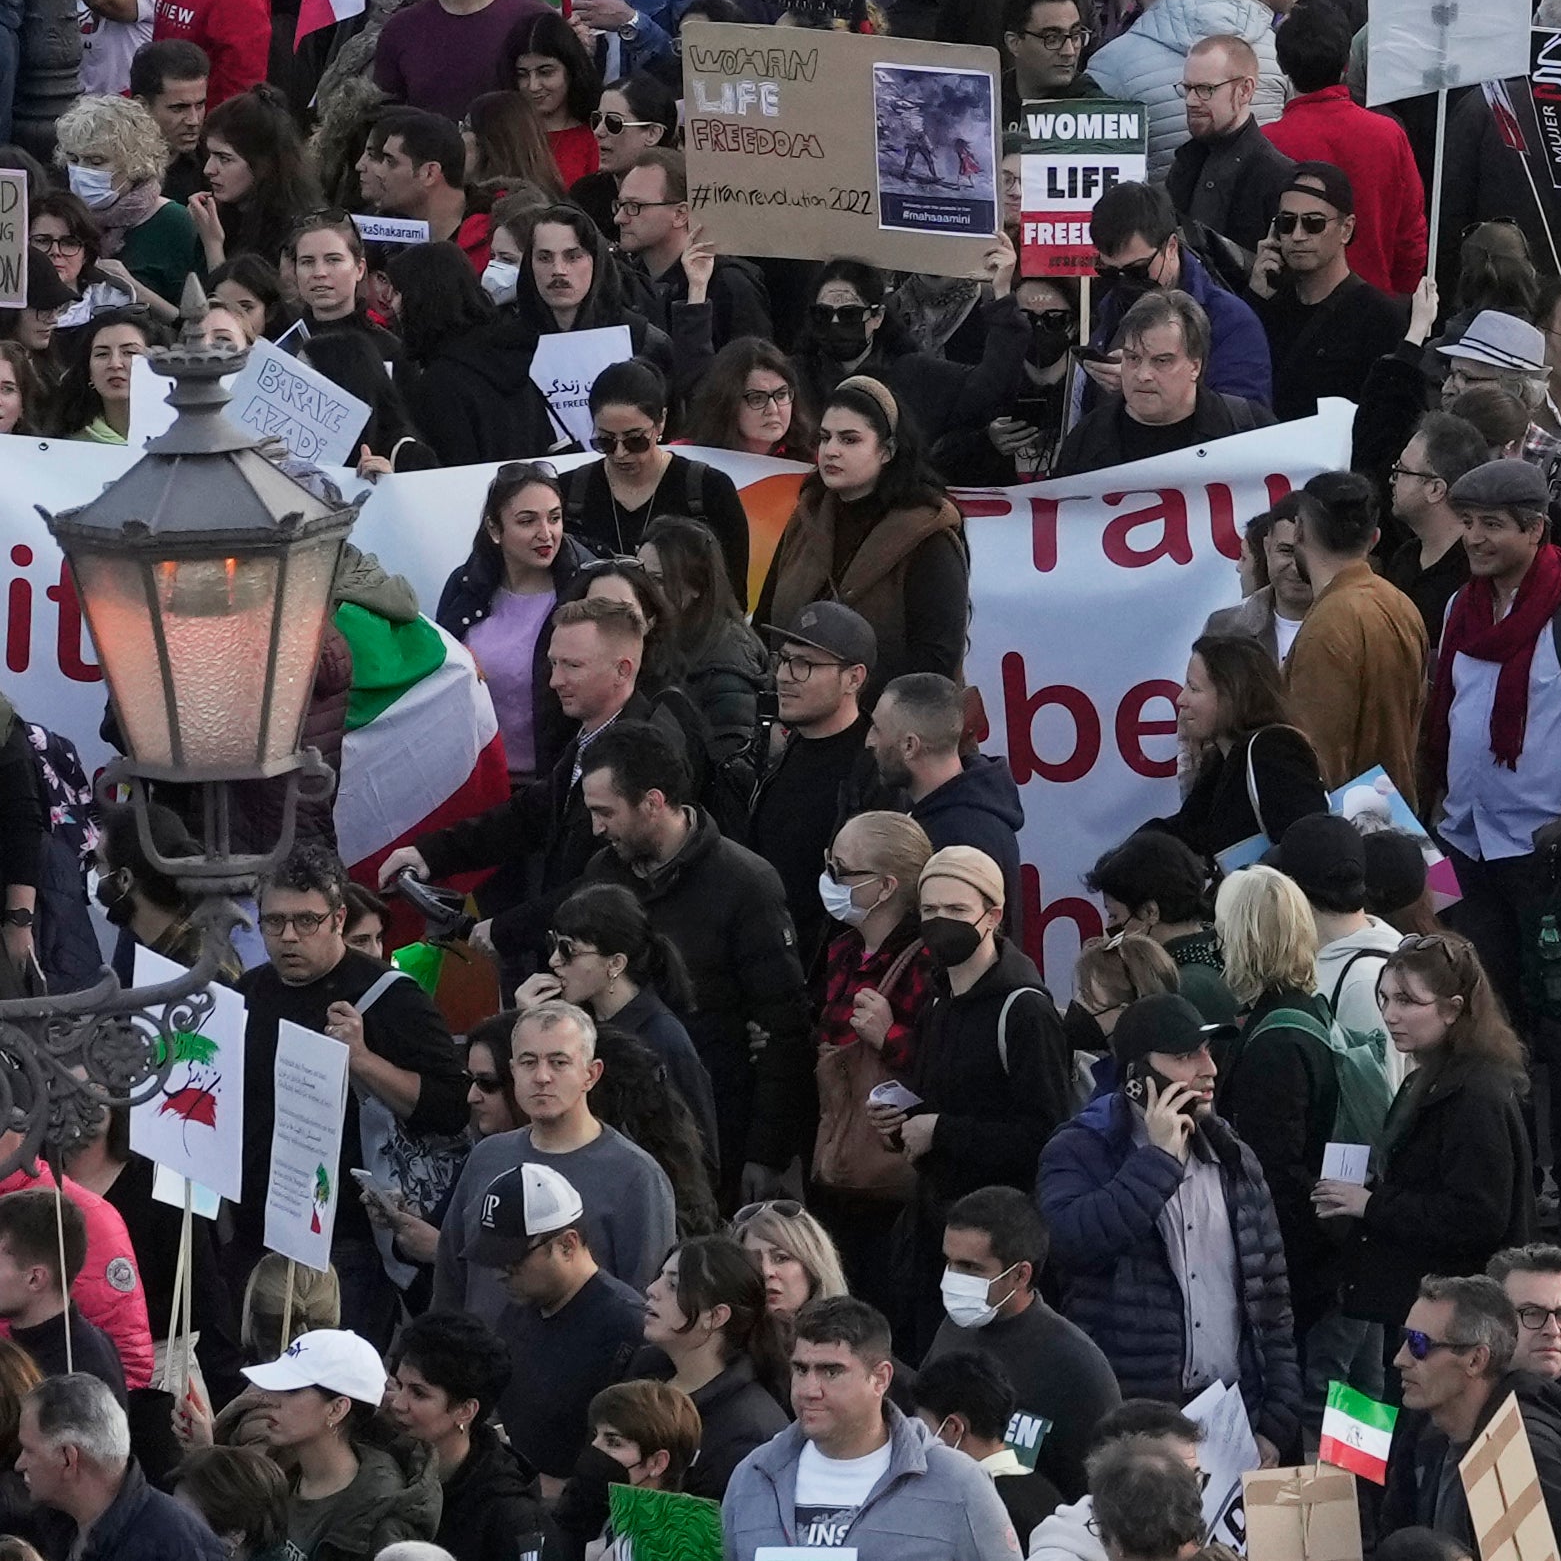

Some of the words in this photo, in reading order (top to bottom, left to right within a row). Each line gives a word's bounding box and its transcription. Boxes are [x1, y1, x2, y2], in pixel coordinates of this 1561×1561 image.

[688, 44, 819, 84] WOMAN
[692, 78, 781, 118] LIFE
[690, 118, 825, 160] FREEDOM
[1026, 112, 1139, 140] WOMEN
[828, 187, 873, 216] 2022
[902, 211, 971, 225] #mahsaamini
[256, 357, 350, 433] BARAYE
